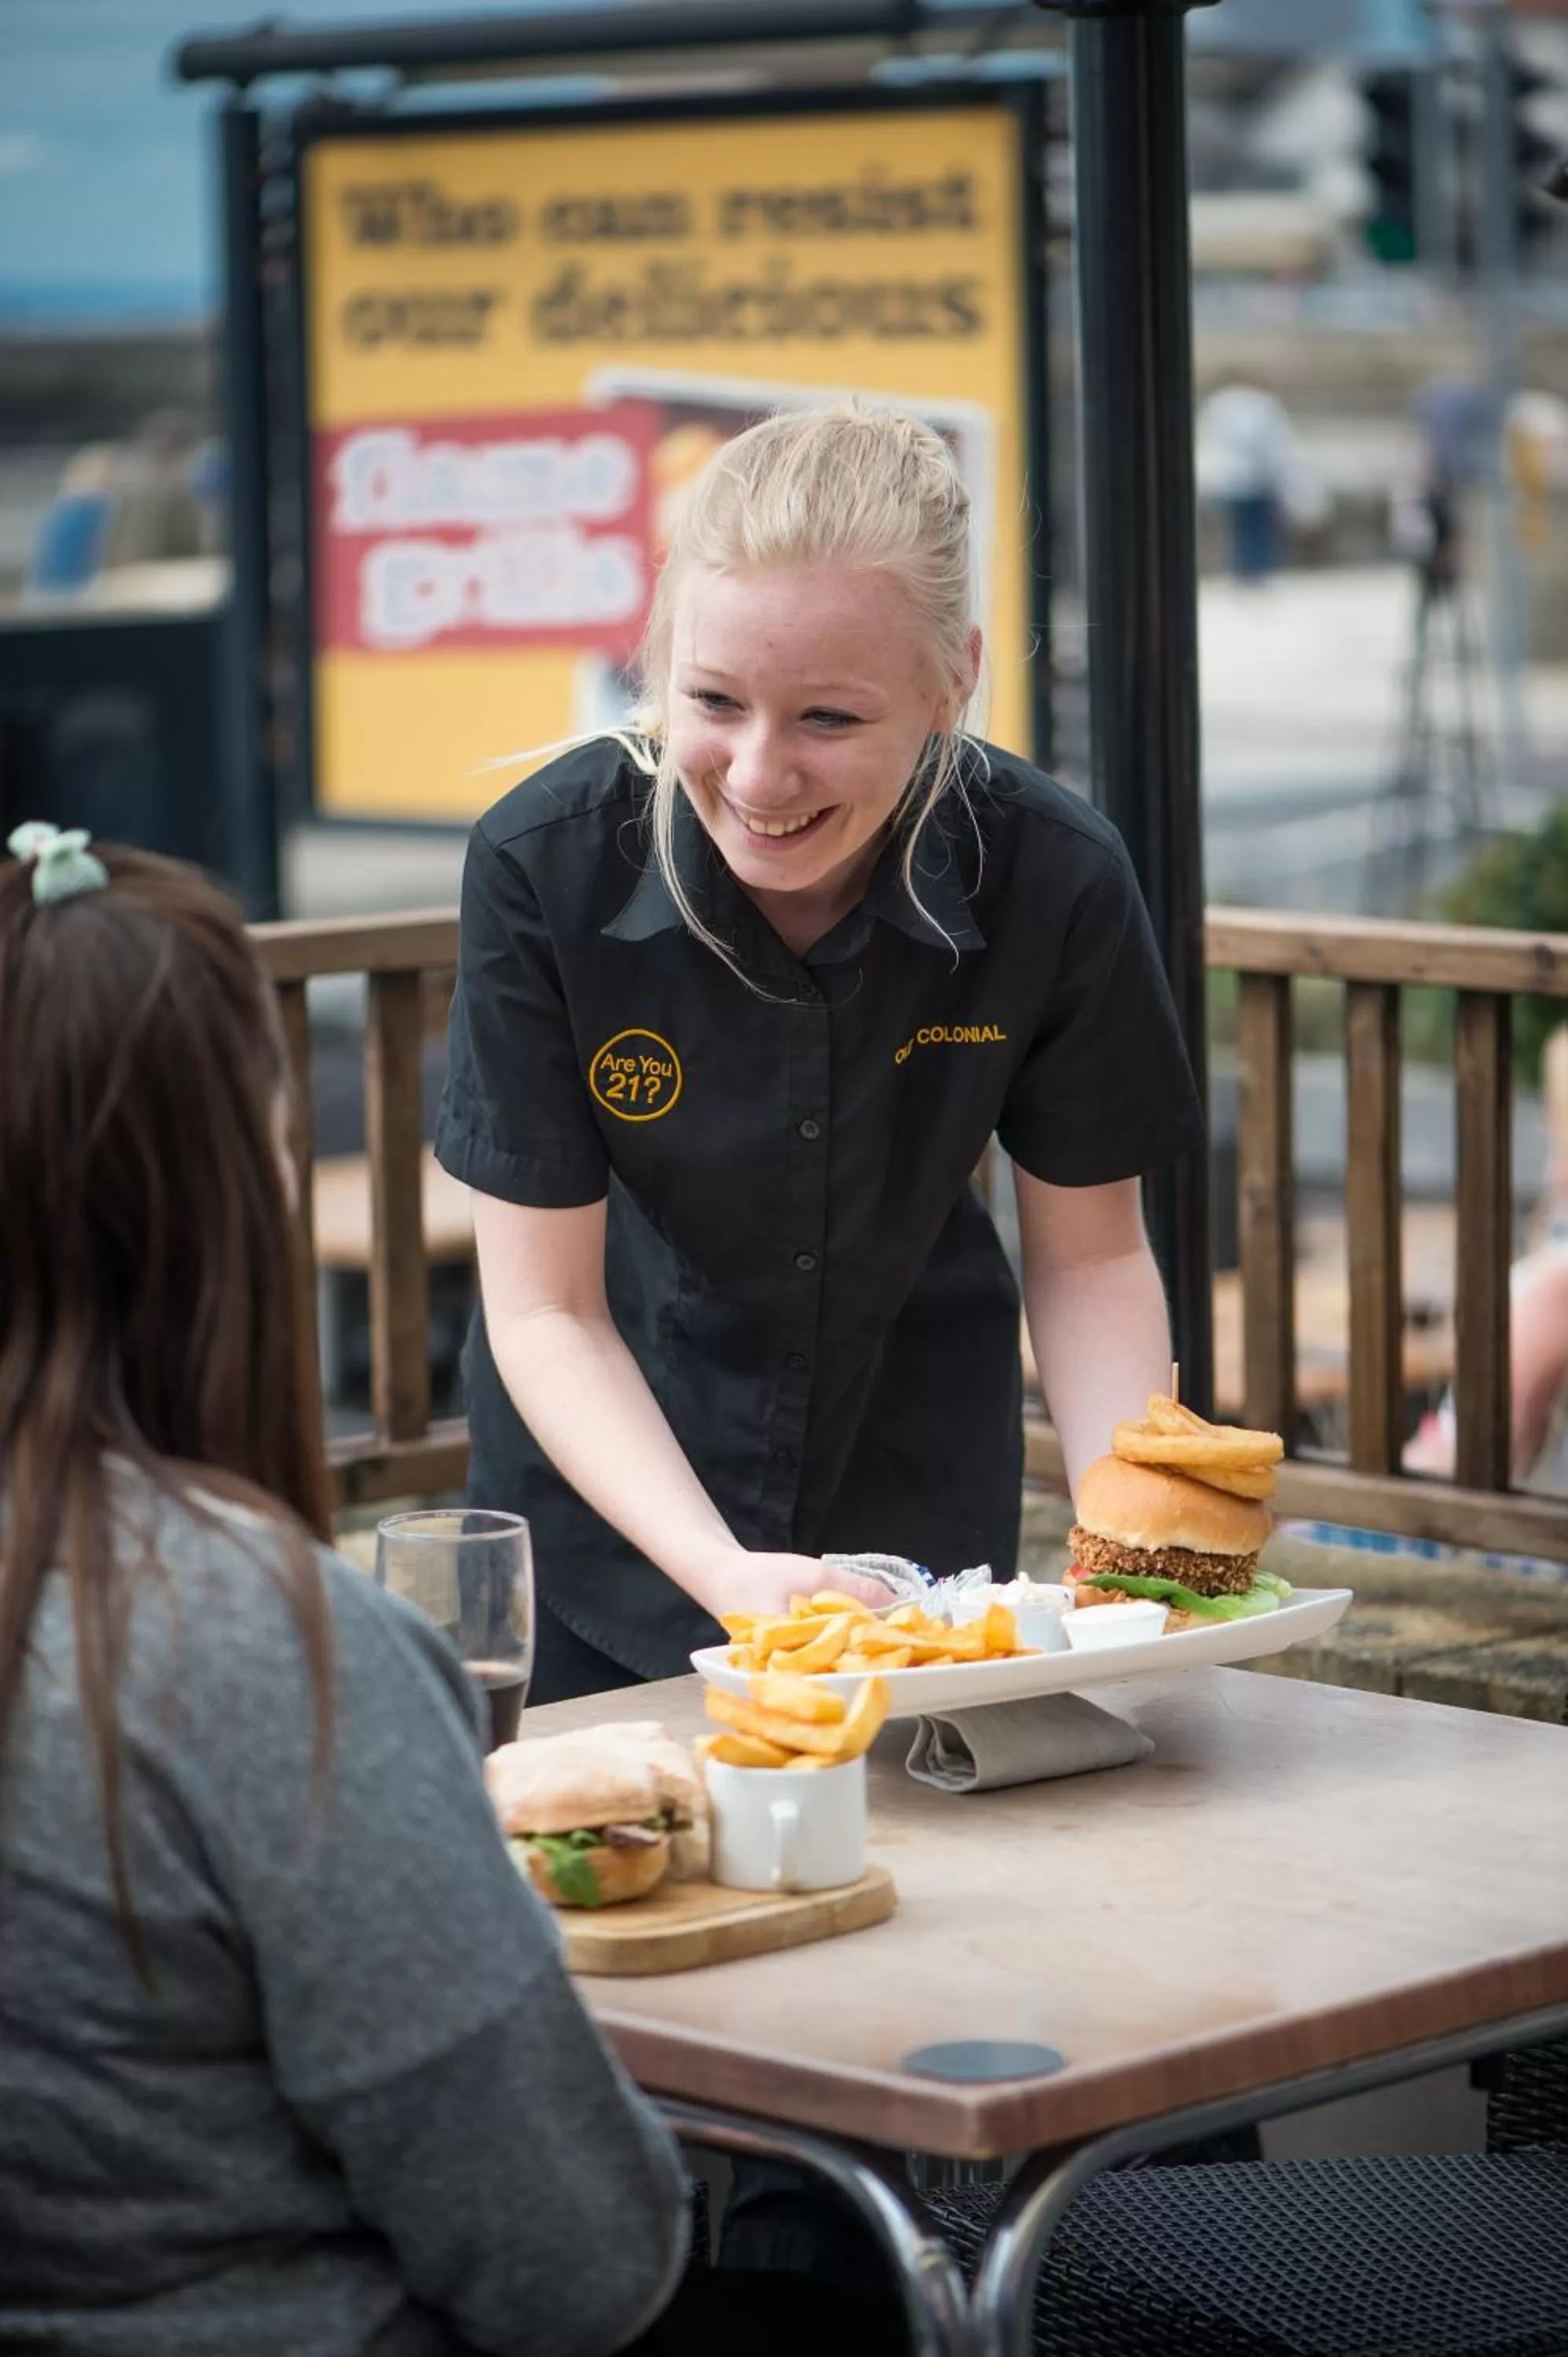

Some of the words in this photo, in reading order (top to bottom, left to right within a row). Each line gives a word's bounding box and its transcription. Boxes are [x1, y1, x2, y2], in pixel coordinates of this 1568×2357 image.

[341, 182, 515, 247] Who
[542, 192, 691, 242] can
[721, 162, 977, 237] resist
[343, 288, 498, 347] our
[533, 262, 984, 346] delicious
[916, 1025, 1006, 1044] COLONIAL
[600, 1053, 636, 1073] Are
[639, 1055, 673, 1079] You
[606, 1072, 661, 1104] 21?
